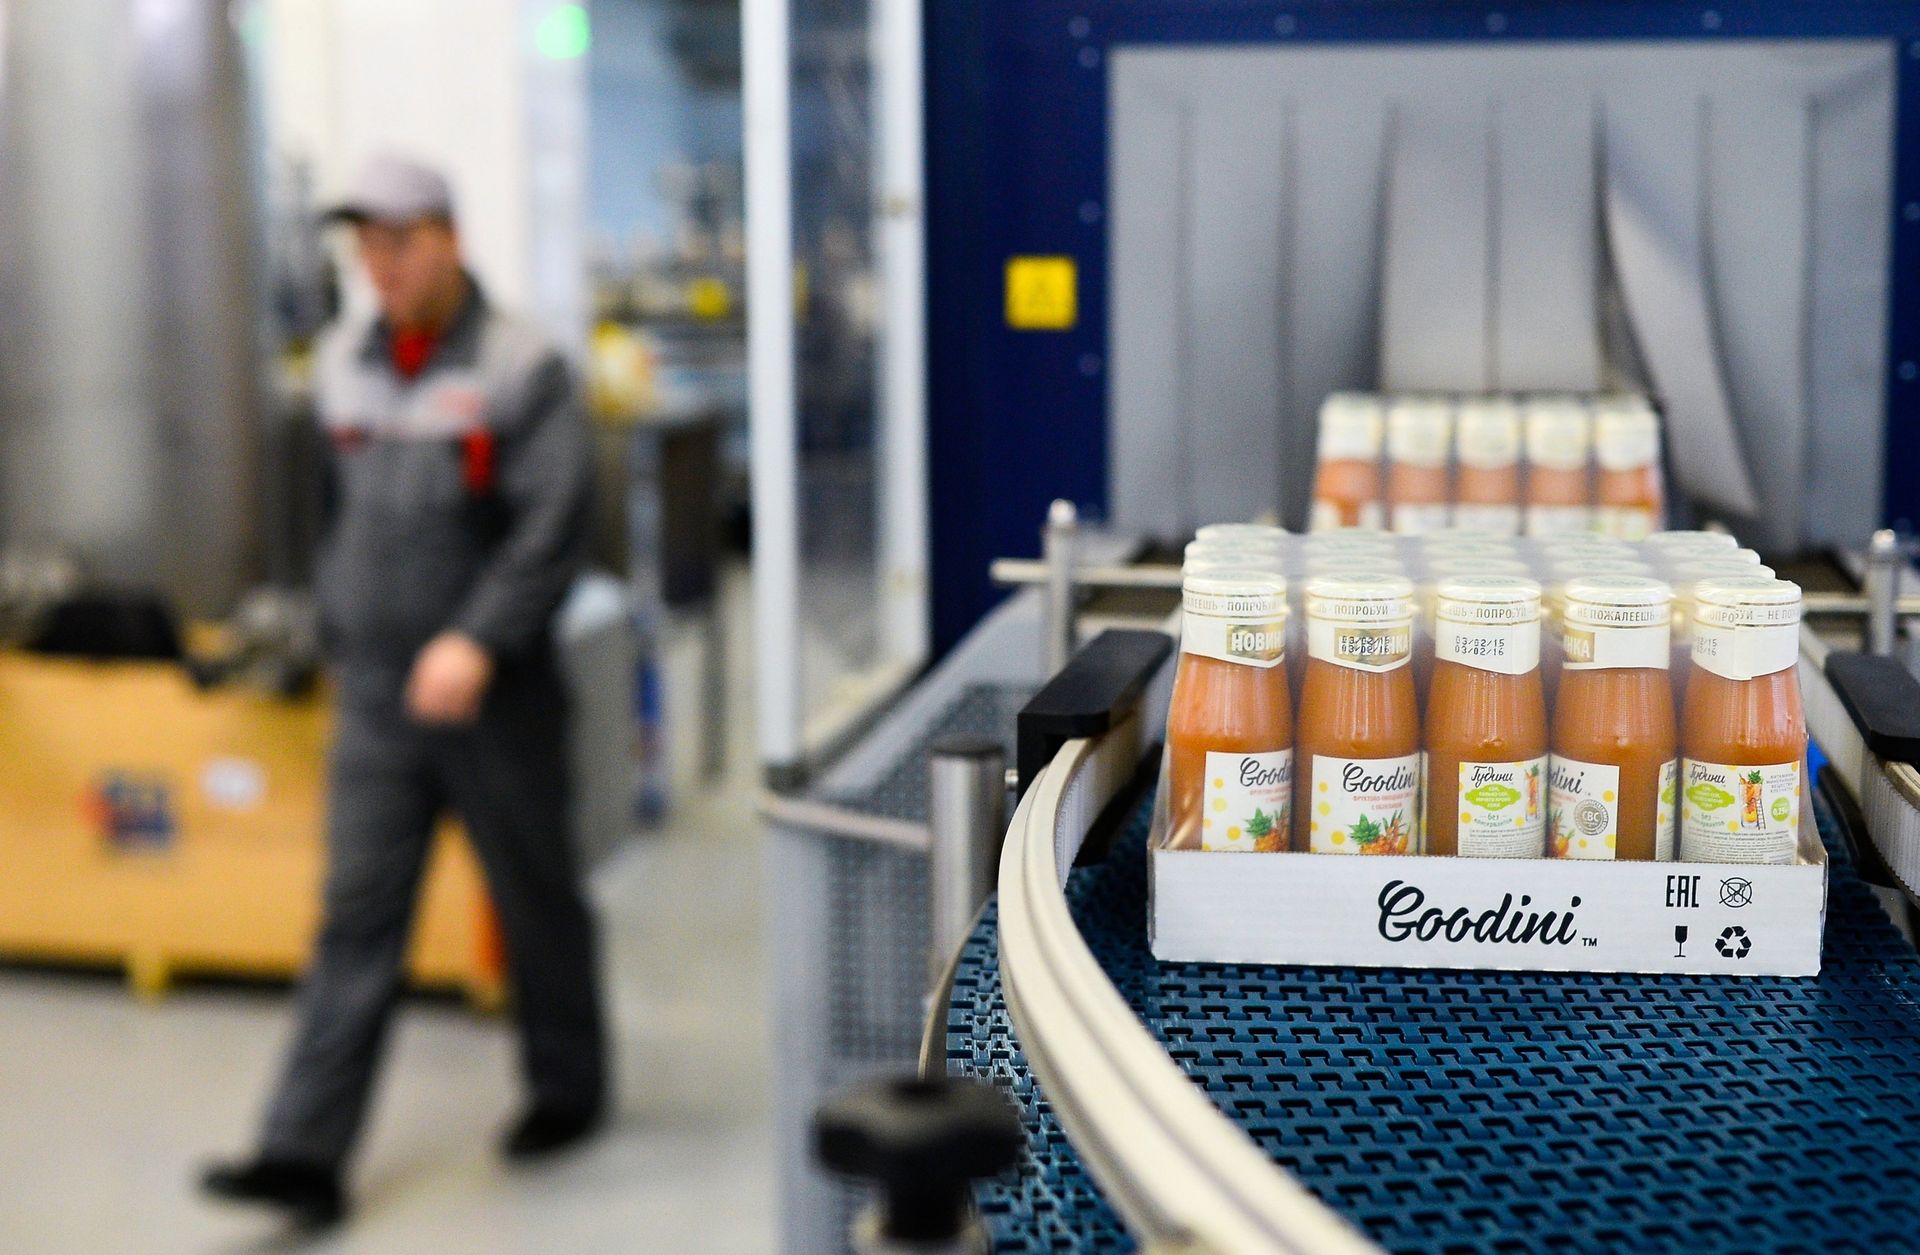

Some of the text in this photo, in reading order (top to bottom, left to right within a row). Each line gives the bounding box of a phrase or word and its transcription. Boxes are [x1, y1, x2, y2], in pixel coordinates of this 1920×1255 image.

[1590, 608, 1655, 622] ПОЖАЛЕЕШЬ
[1455, 644, 1504, 656] 03/02/16
[1456, 635, 1504, 648] 03/02/15
[1342, 762, 1417, 793] Goodini
[1471, 765, 1514, 788] Гудини
[1690, 763, 1726, 786] Гудини
[1665, 874, 1700, 908] EAC
[1378, 879, 1598, 947] Goodini TM
